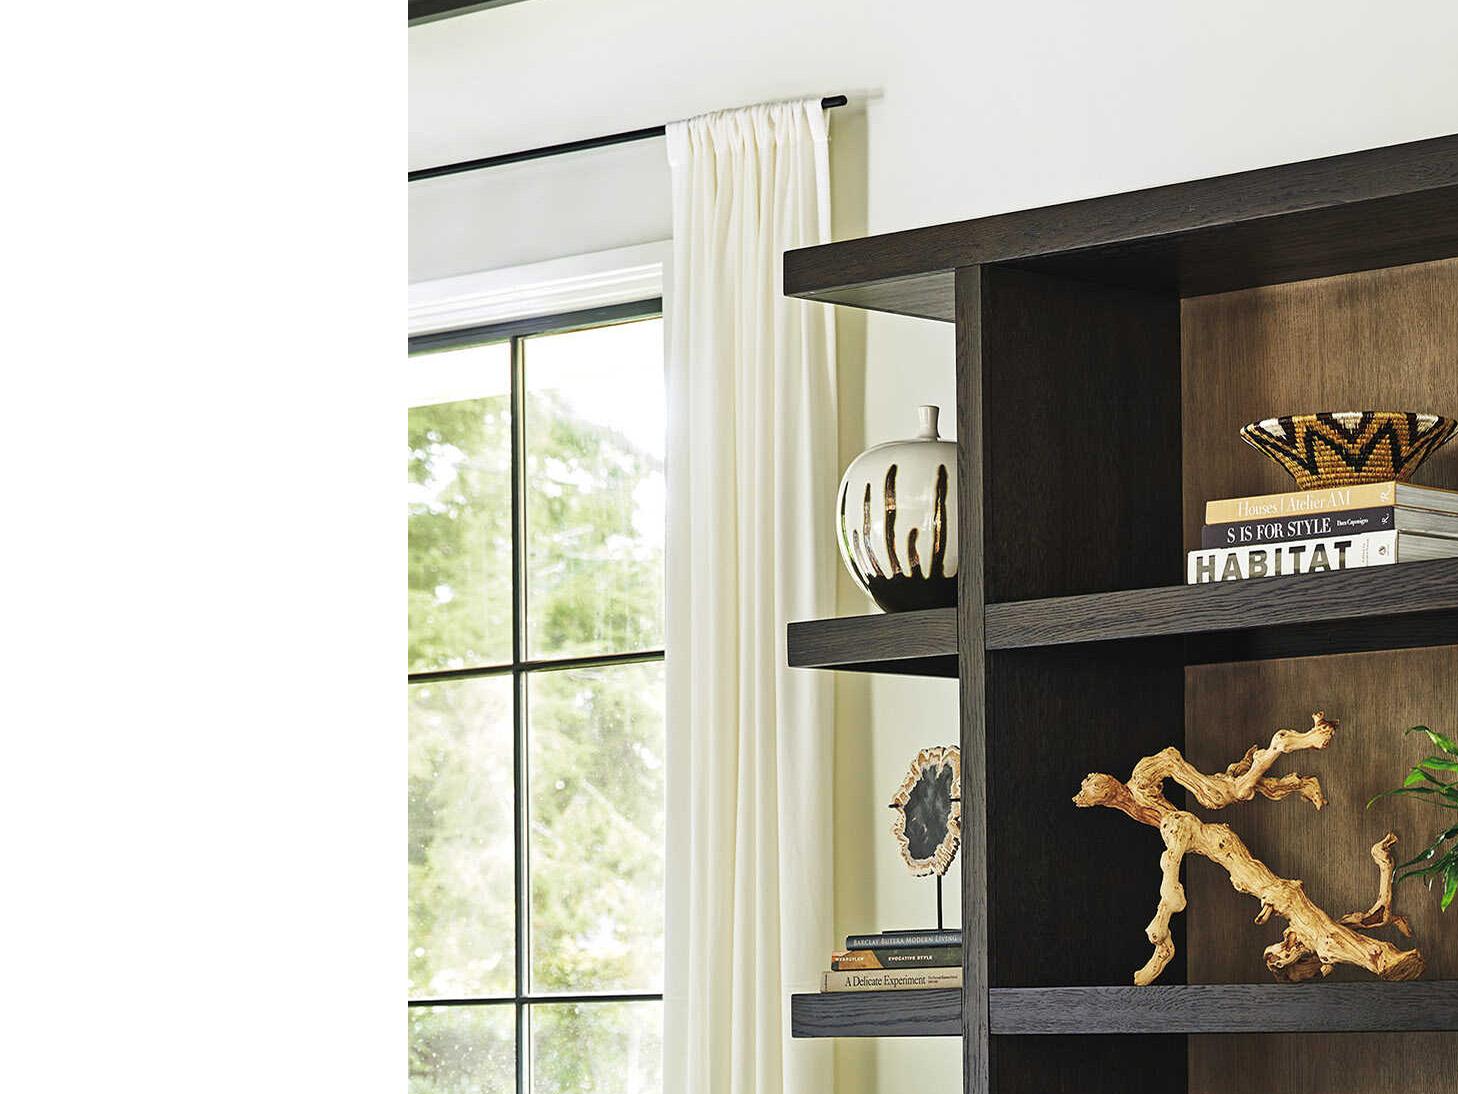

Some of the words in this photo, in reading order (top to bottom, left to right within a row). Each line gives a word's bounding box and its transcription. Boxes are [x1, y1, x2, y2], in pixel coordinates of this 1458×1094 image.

[1238, 499, 1278, 517] Houses
[1288, 492, 1324, 512] Atelier
[1327, 488, 1352, 507] AM
[1227, 527, 1236, 543] S
[1240, 525, 1252, 542] IS
[1256, 522, 1284, 540] FOR
[1287, 517, 1332, 537] STYLE
[1196, 540, 1352, 583] HABITAT
[845, 976, 852, 987] A
[853, 975, 882, 987] Delicate
[884, 974, 926, 988] Experiment
